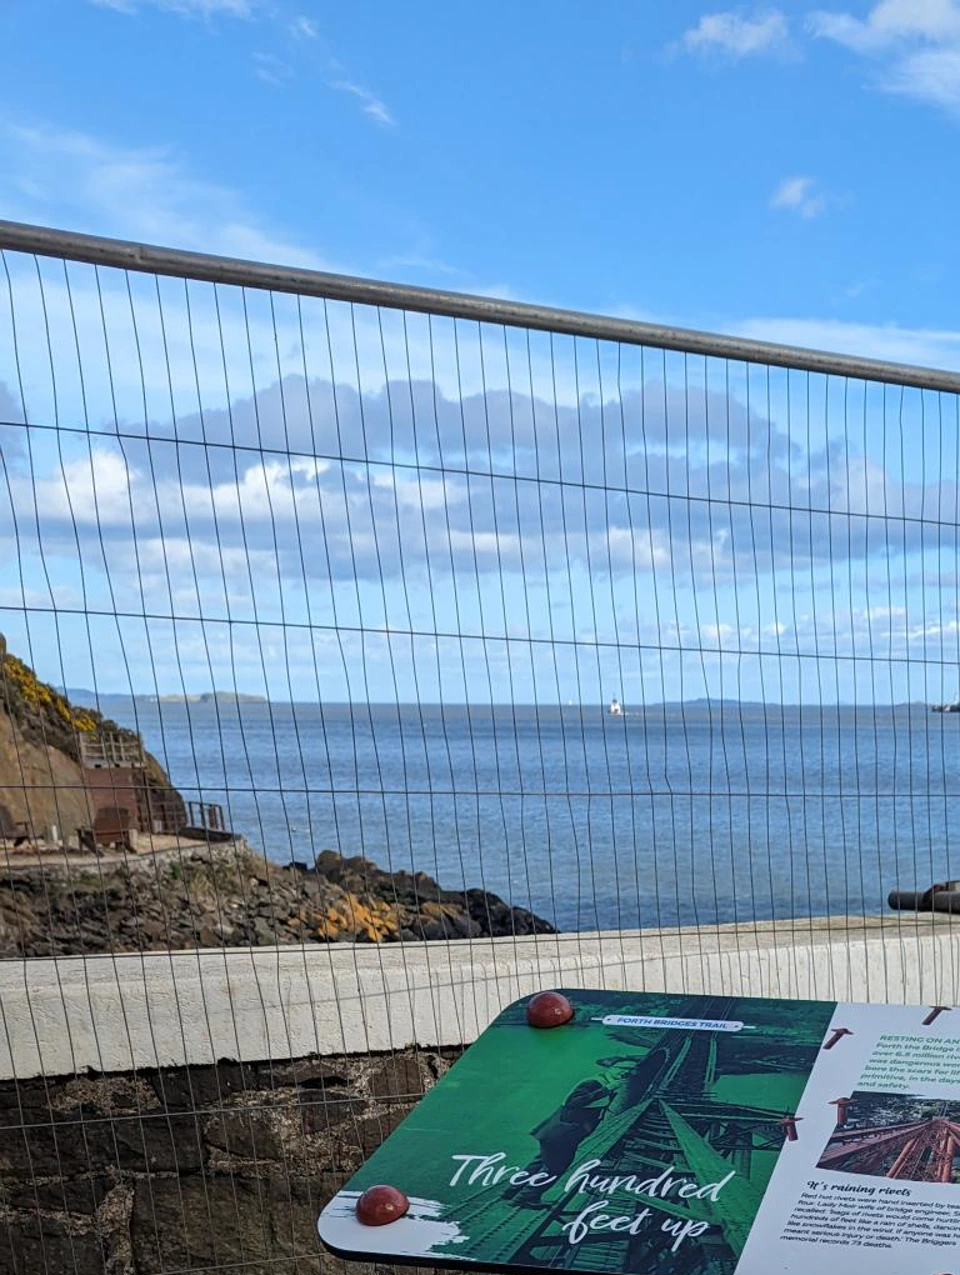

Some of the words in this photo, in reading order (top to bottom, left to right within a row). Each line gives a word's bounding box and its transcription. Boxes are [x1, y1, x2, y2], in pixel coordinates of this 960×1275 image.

[617, 1016, 652, 1024] FORTH
[880, 1035, 924, 1043] RESTING
[922, 1045, 954, 1053] Bridge
[449, 1151, 558, 1187] Three
[564, 1158, 736, 1203] hundred
[807, 1180, 828, 1191] It's
[831, 1184, 876, 1196] raining
[878, 1187, 912, 1197] rivets
[562, 1199, 654, 1245] feet
[660, 1219, 710, 1252] up
